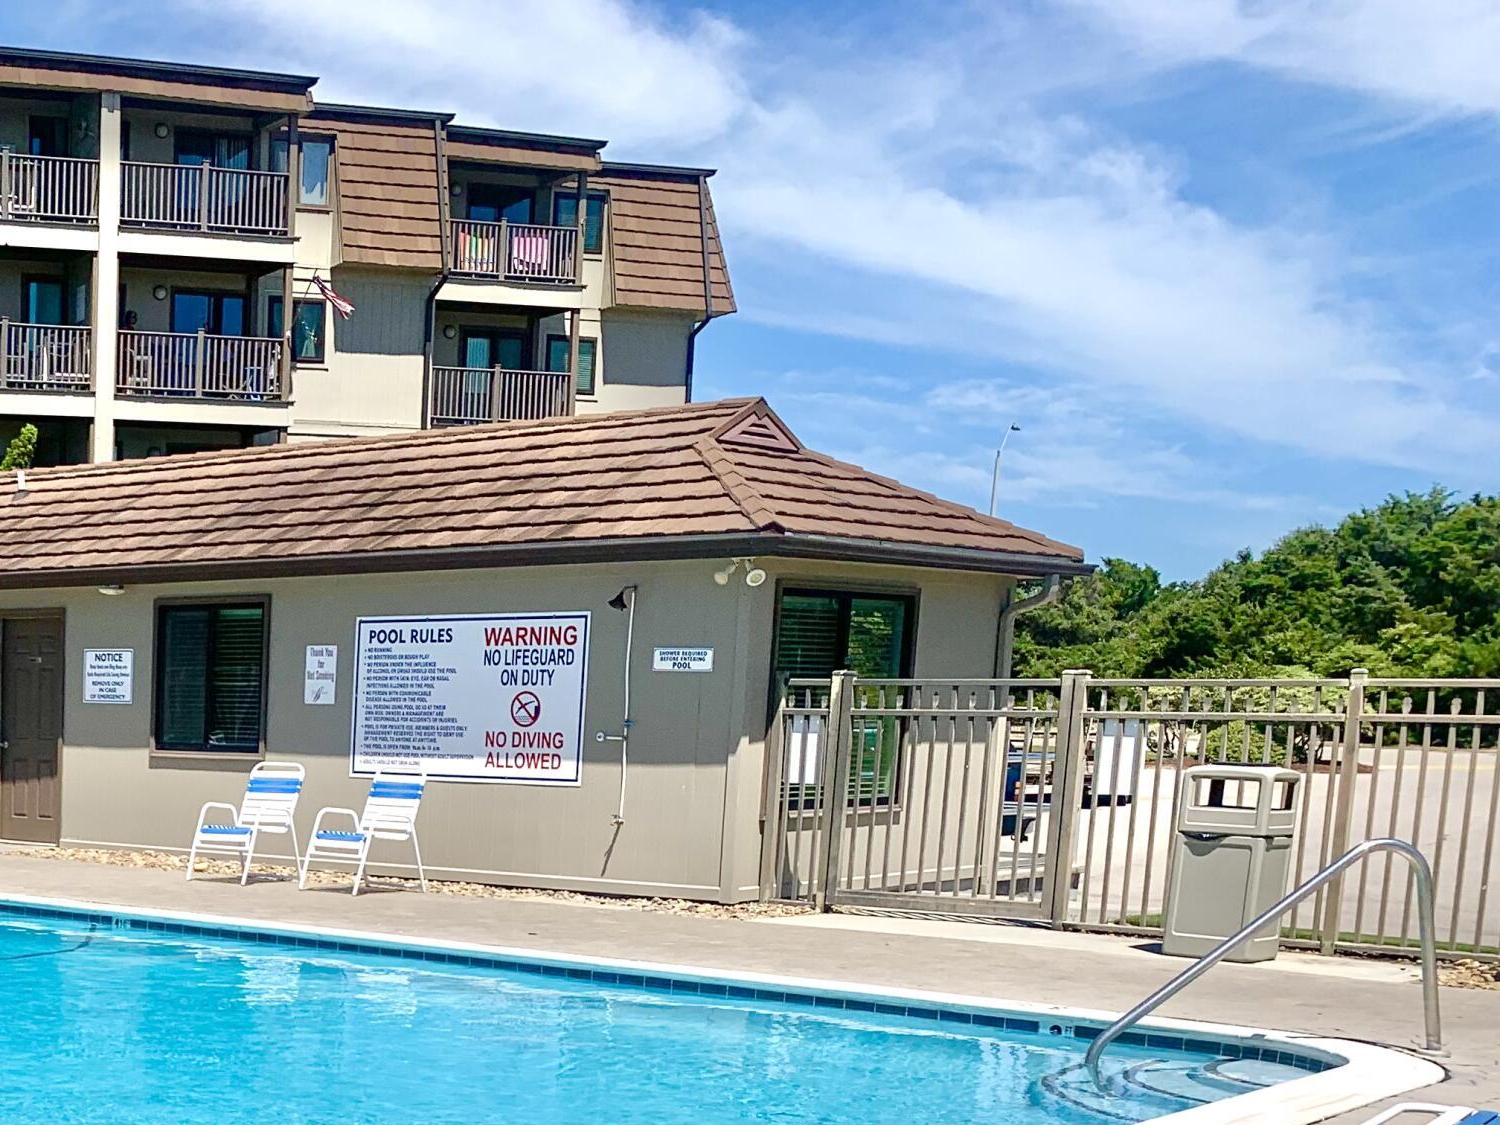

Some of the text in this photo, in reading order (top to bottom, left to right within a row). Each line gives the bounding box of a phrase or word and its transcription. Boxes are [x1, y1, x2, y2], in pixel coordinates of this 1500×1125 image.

[369, 628, 453, 644] POOL RULES
[485, 625, 578, 646] WARNING
[95, 653, 123, 662] NOTICE
[484, 648, 575, 666] NO LIFEGUARD
[501, 669, 555, 686] ON DUTY
[485, 731, 564, 749] NO DIVING
[485, 752, 562, 769] ALLOWED
